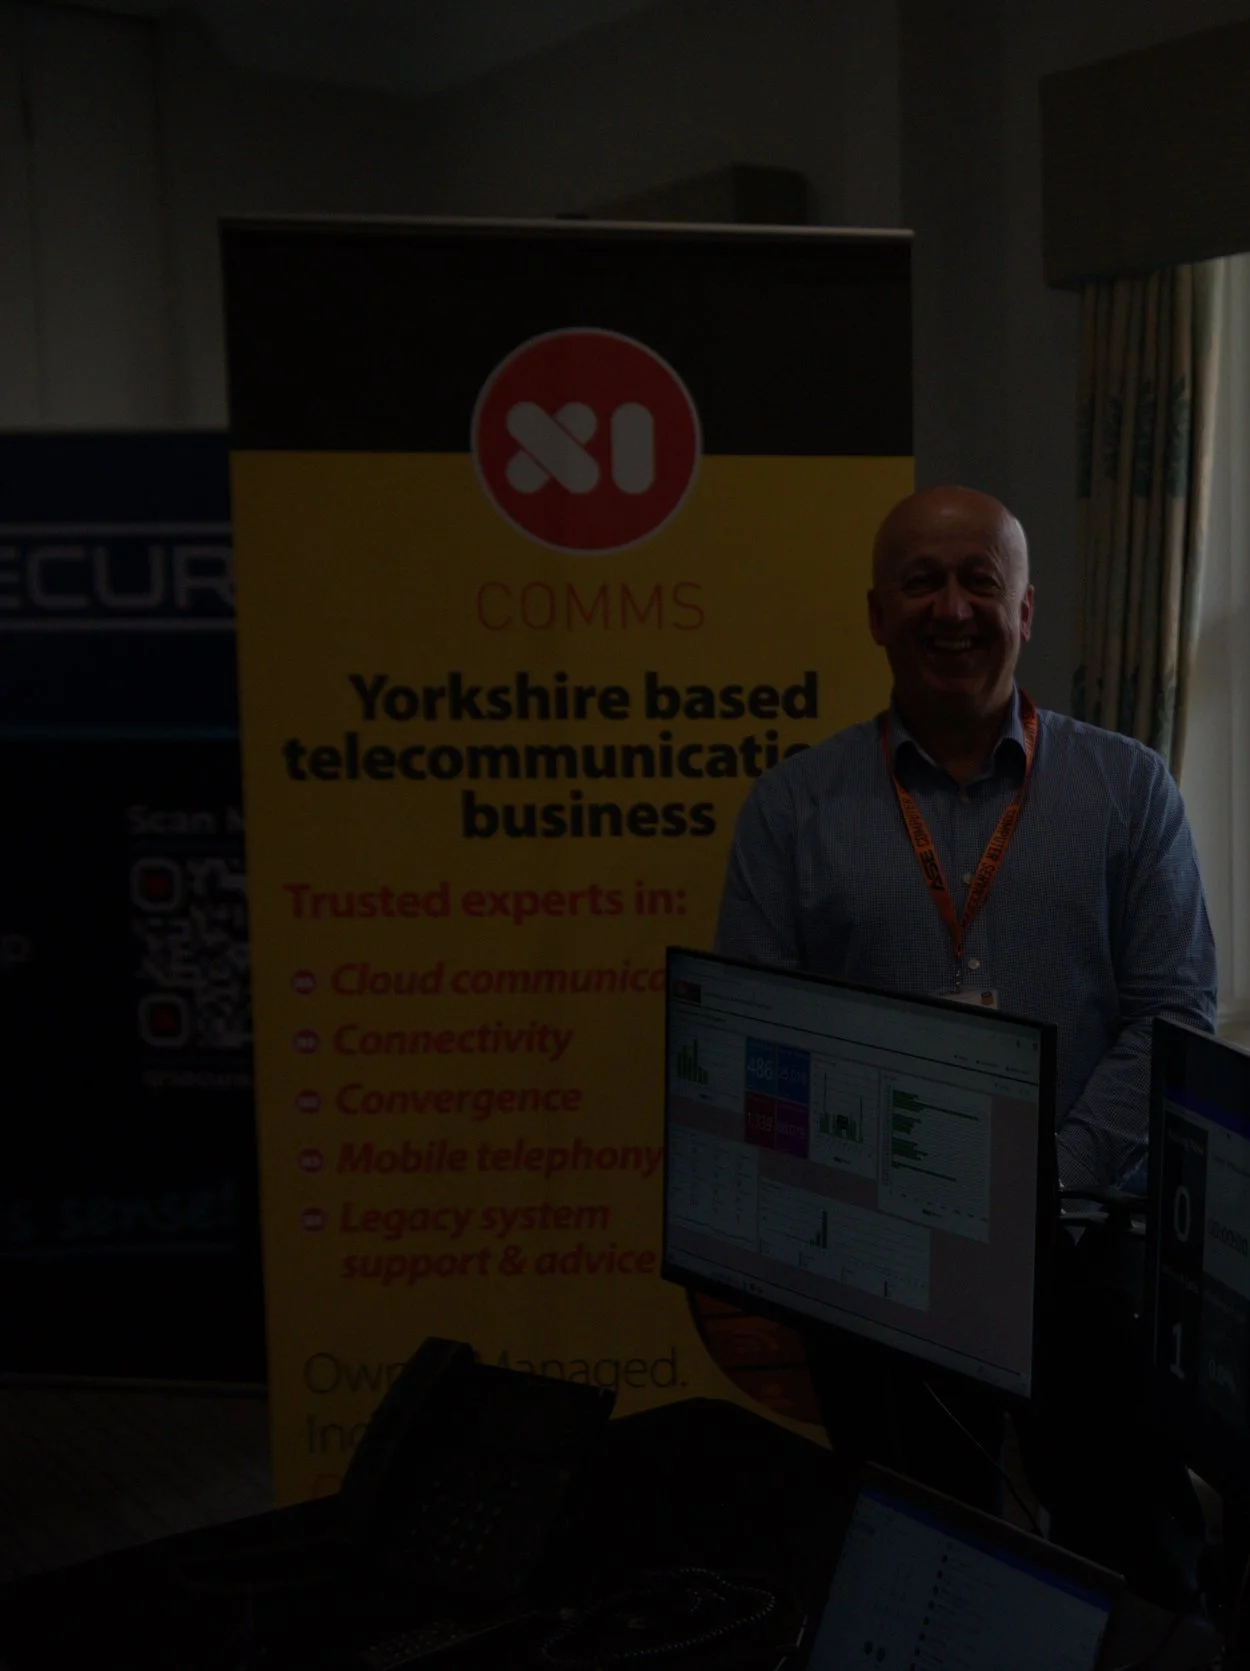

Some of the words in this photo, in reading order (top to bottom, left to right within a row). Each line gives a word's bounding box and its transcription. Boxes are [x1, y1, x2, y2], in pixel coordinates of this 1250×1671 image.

[476, 581, 705, 632] COMMS
[349, 671, 629, 721] Yorkshire
[646, 671, 817, 719] based
[462, 791, 716, 838] business
[283, 882, 451, 919] Trusted
[461, 883, 624, 925] experts
[635, 880, 687, 916] in:
[331, 961, 445, 996] Cloud
[333, 1022, 573, 1060] Connectivity
[335, 1083, 583, 1120] Convergence
[337, 1141, 468, 1175] Mobile
[477, 1138, 664, 1179] telephony
[339, 1202, 473, 1240] Legacy
[482, 1204, 610, 1238] system
[1173, 1185, 1191, 1242] 0
[341, 1247, 491, 1286] support
[499, 1245, 526, 1277] &
[535, 1243, 655, 1276] advice
[1169, 1320, 1186, 1381] 1
